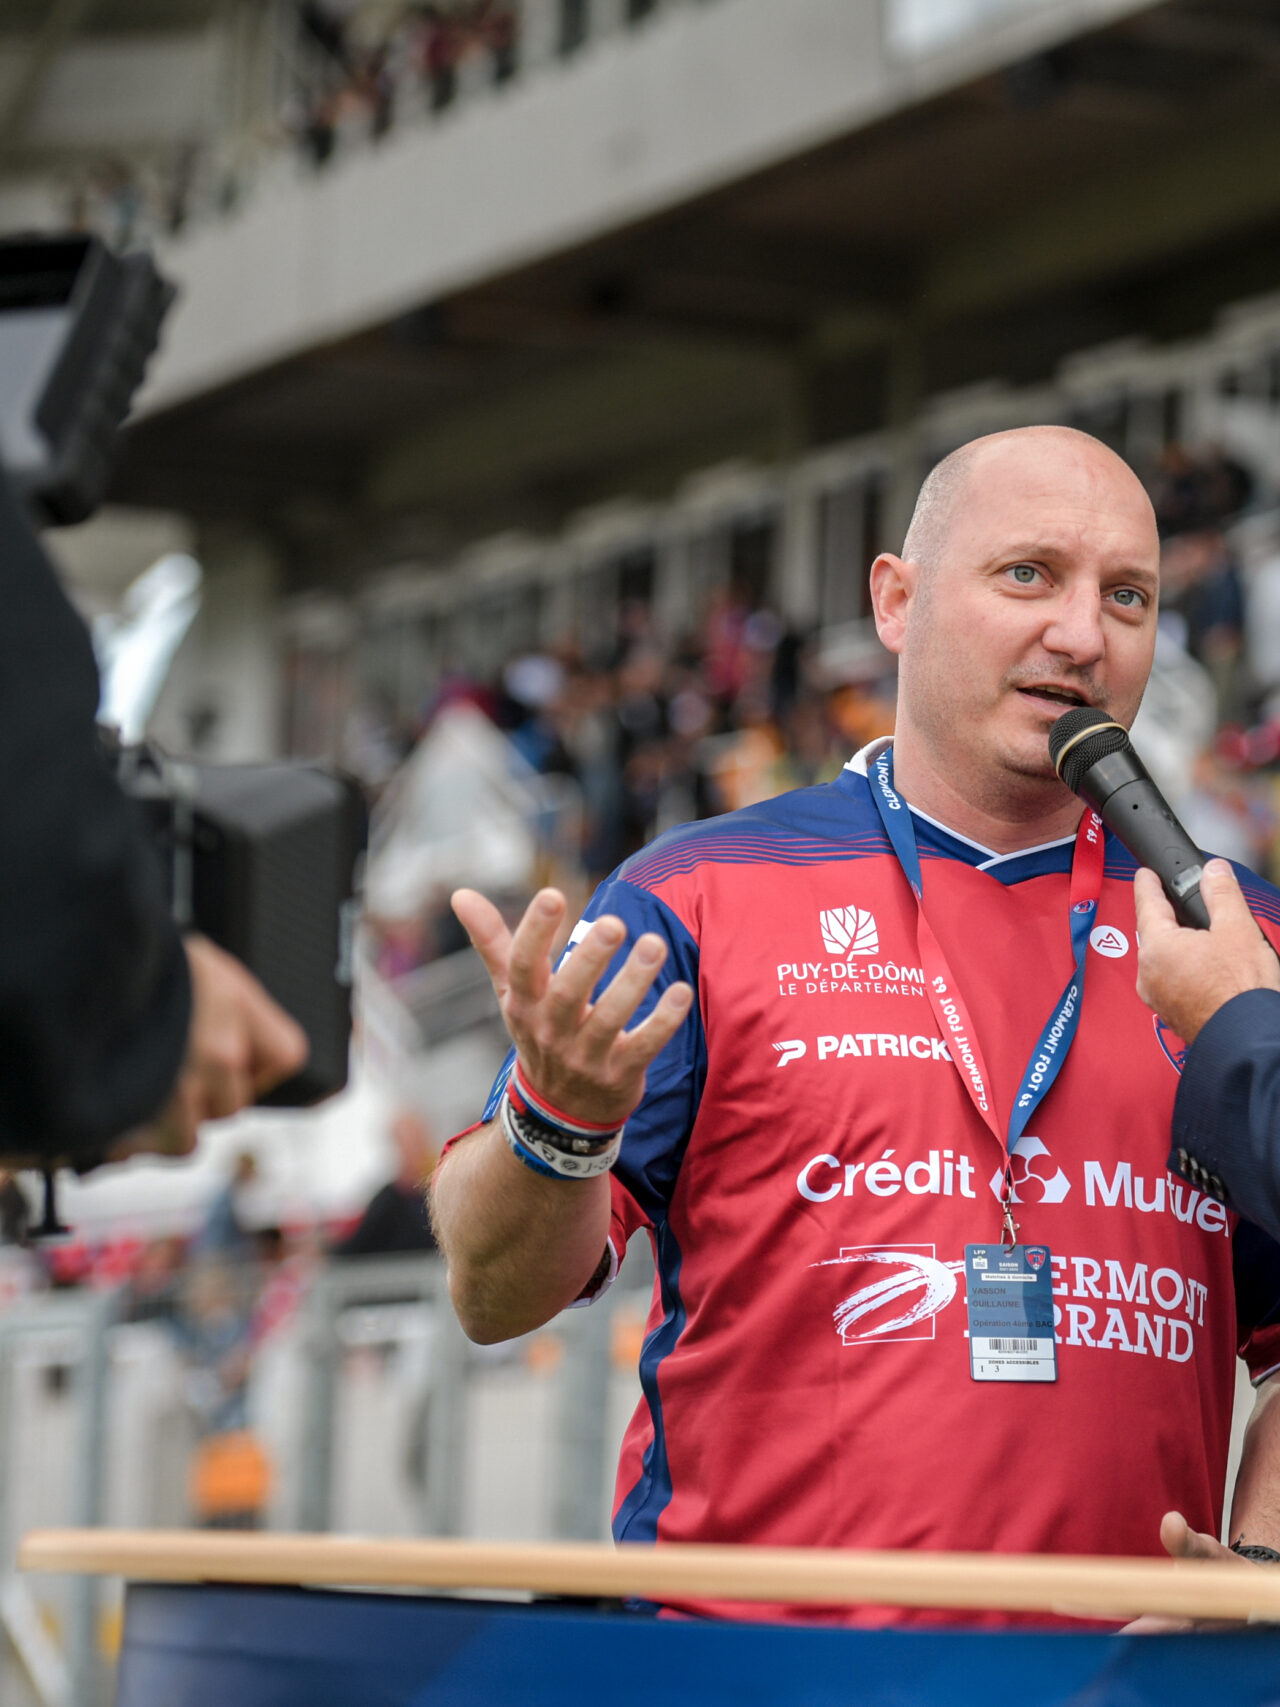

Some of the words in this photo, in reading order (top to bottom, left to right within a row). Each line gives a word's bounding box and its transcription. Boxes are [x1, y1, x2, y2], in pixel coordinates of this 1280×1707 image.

[1086, 829, 1098, 844] 63
[778, 983, 798, 996] LE
[806, 979, 928, 997] DÉPARTEMEN
[931, 975, 947, 994] 63
[940, 997, 964, 1032] FOOT
[1043, 984, 1078, 1055] CLERMONT
[816, 1033, 953, 1062] PATRICK
[954, 1035, 989, 1112] CLERMONT
[1027, 1053, 1052, 1092] FOOT
[1018, 1092, 1033, 1108] 63
[796, 1149, 977, 1203] Crédit
[972, 1287, 1006, 1295] VASSON
[1050, 1256, 1208, 1327] ERMONT
[972, 1300, 1020, 1308] GUILLAUME
[1035, 1320, 1053, 1328] BAC
